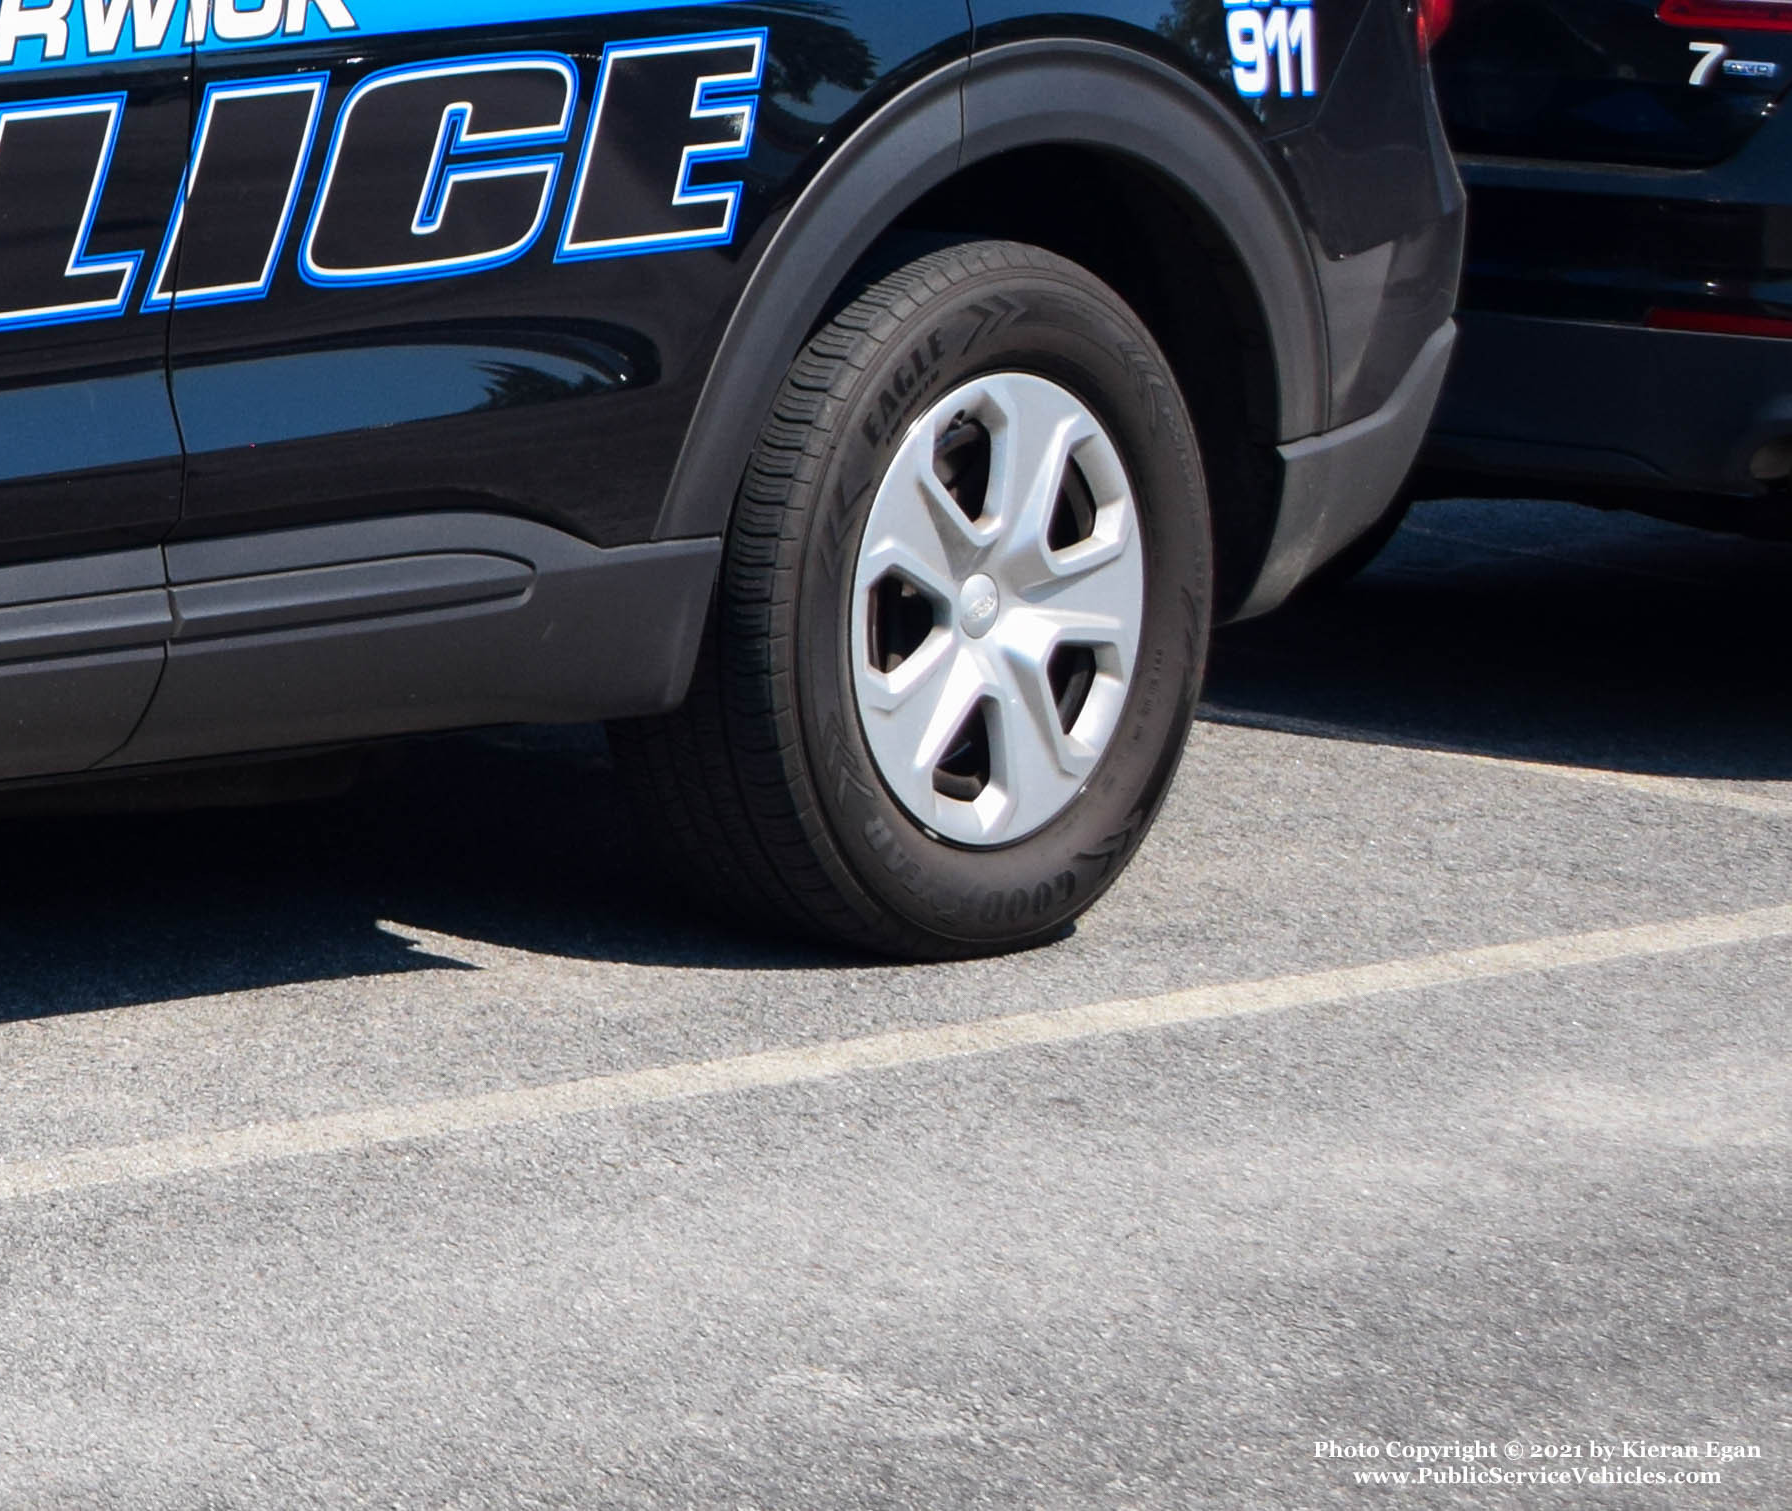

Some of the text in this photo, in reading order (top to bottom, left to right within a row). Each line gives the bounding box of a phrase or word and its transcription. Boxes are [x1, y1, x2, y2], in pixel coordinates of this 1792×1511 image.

[1226, 7, 1318, 99] 911
[1688, 42, 1728, 86] 7
[862, 327, 946, 449] EAGLE
